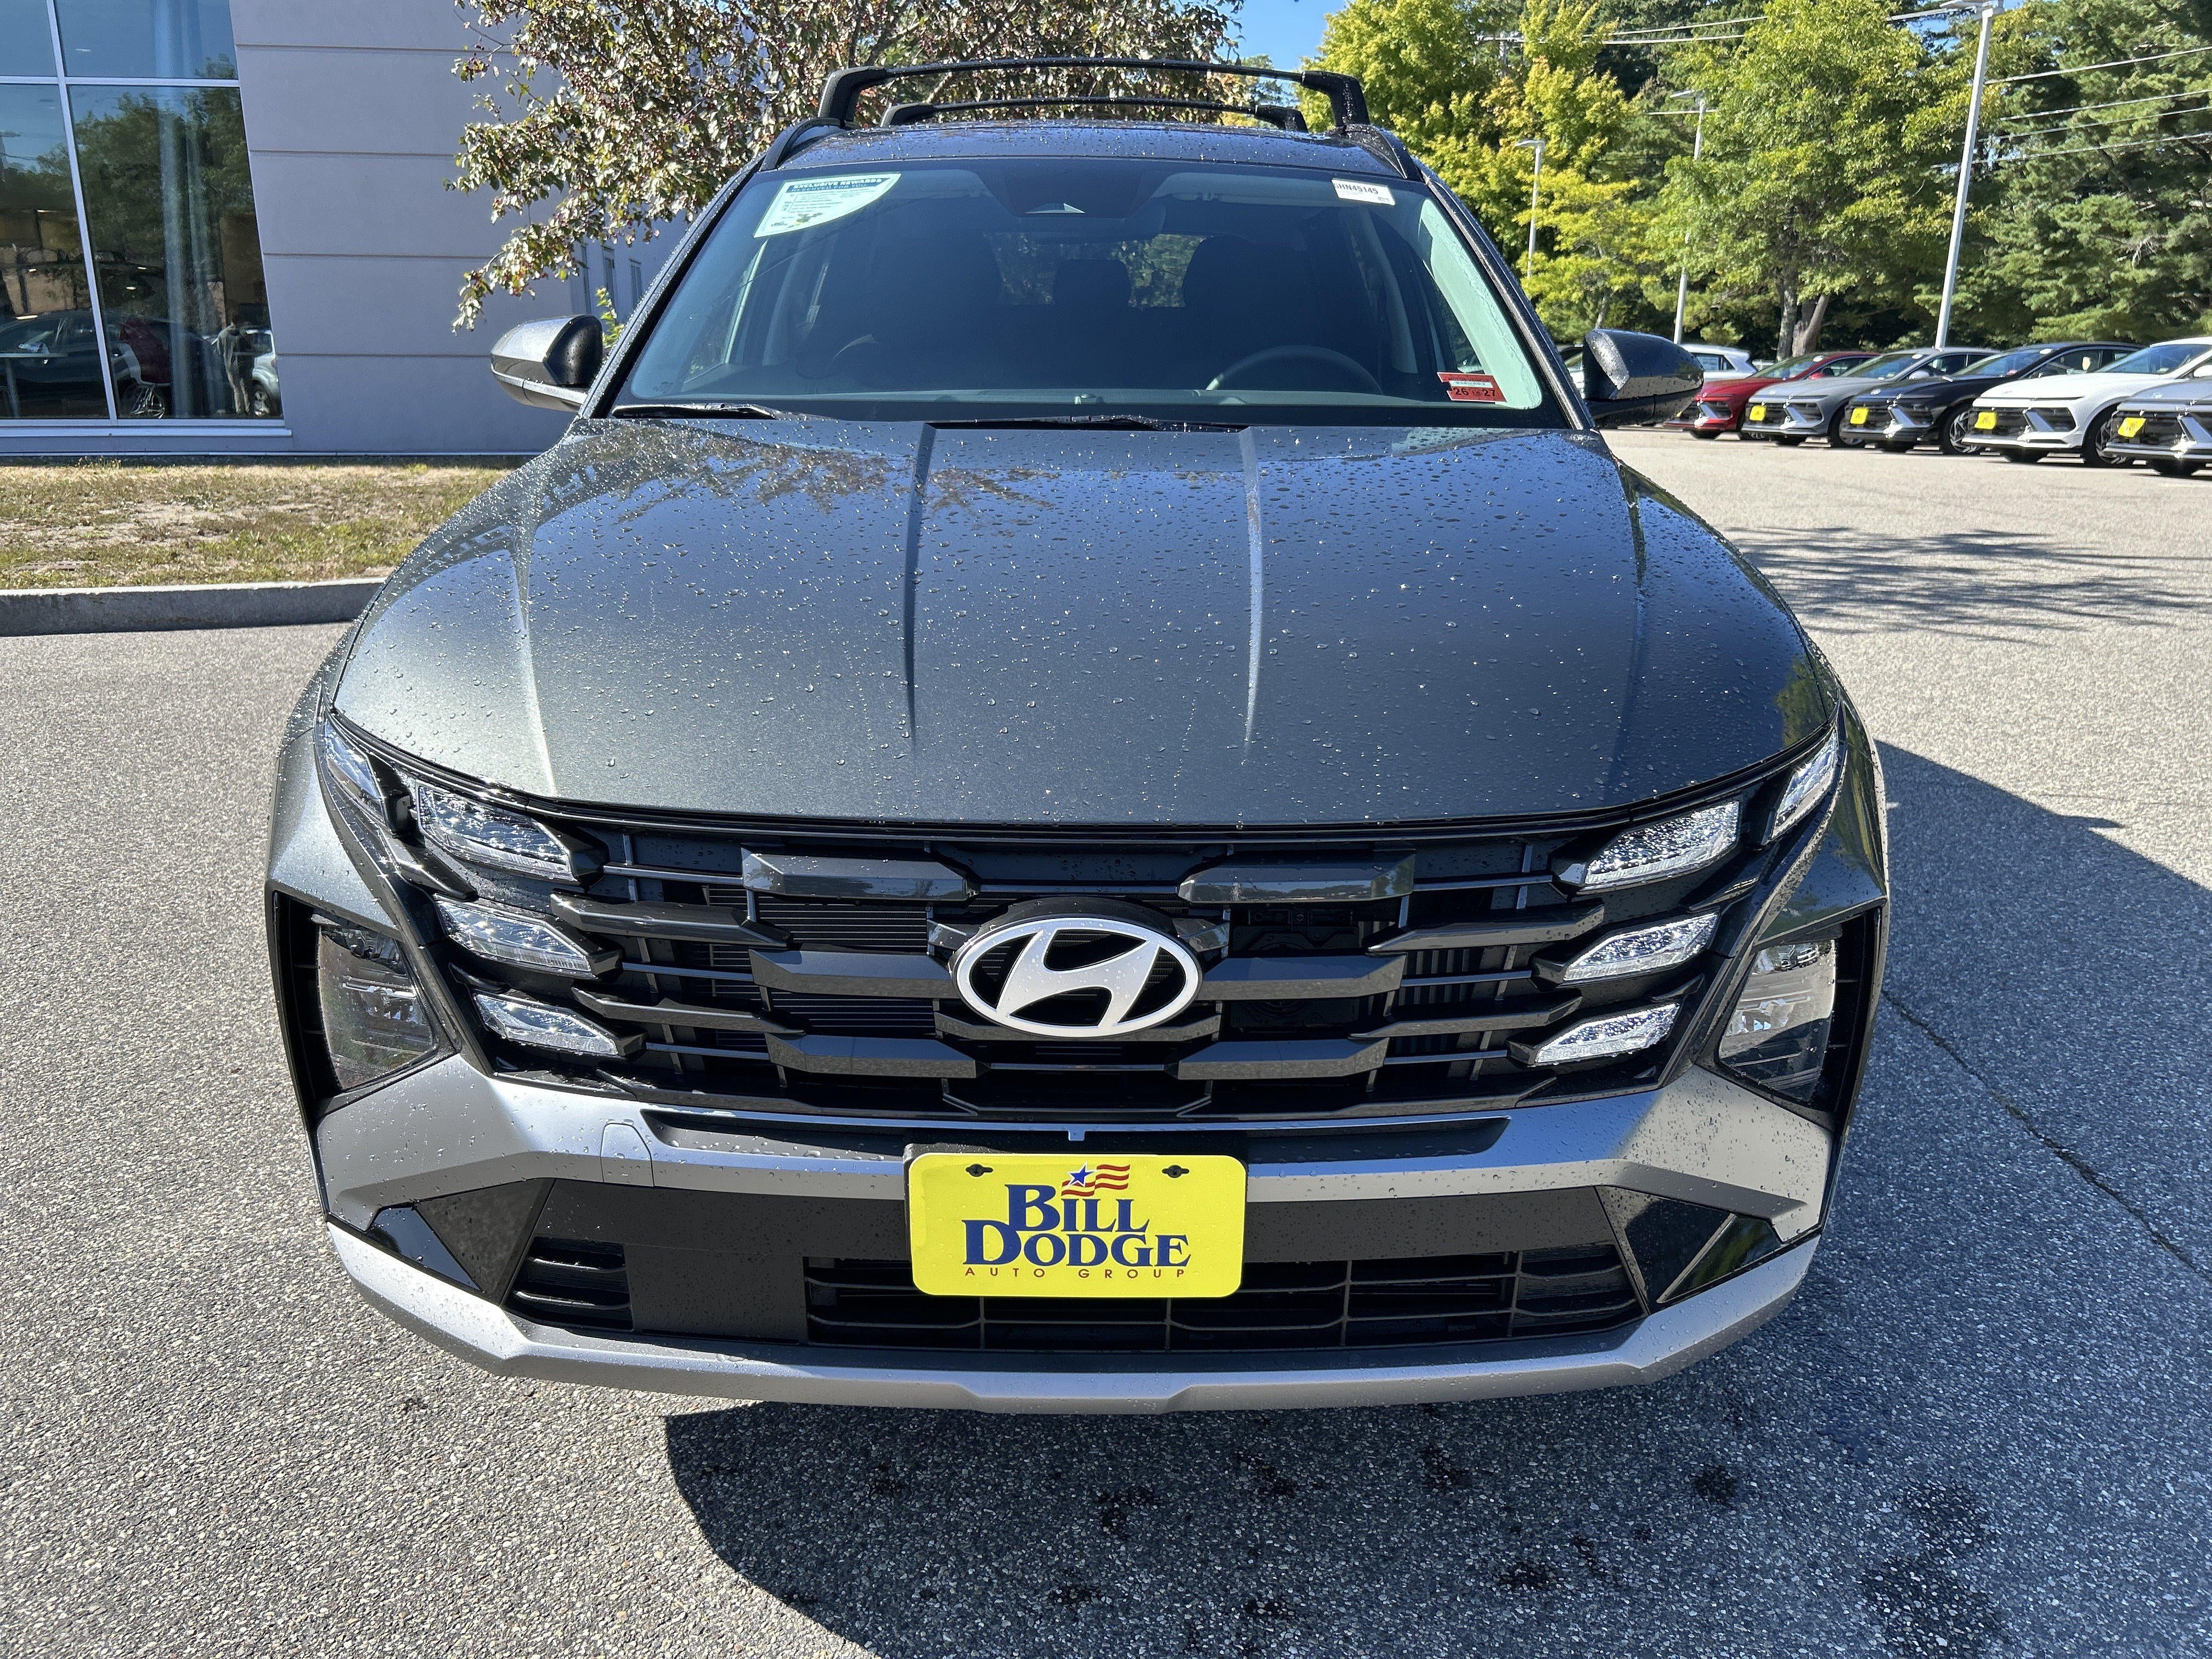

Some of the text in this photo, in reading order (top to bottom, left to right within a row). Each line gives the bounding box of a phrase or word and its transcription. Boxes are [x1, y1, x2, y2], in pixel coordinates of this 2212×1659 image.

[793, 180, 839, 189] EXCLUSIVE
[1453, 387, 1469, 396] 26
[1482, 388, 1496, 397] 27
[1005, 1183, 1150, 1233] BILL
[961, 1219, 1192, 1267] DODGE
[964, 1267, 1185, 1279] AUTO GROUP
